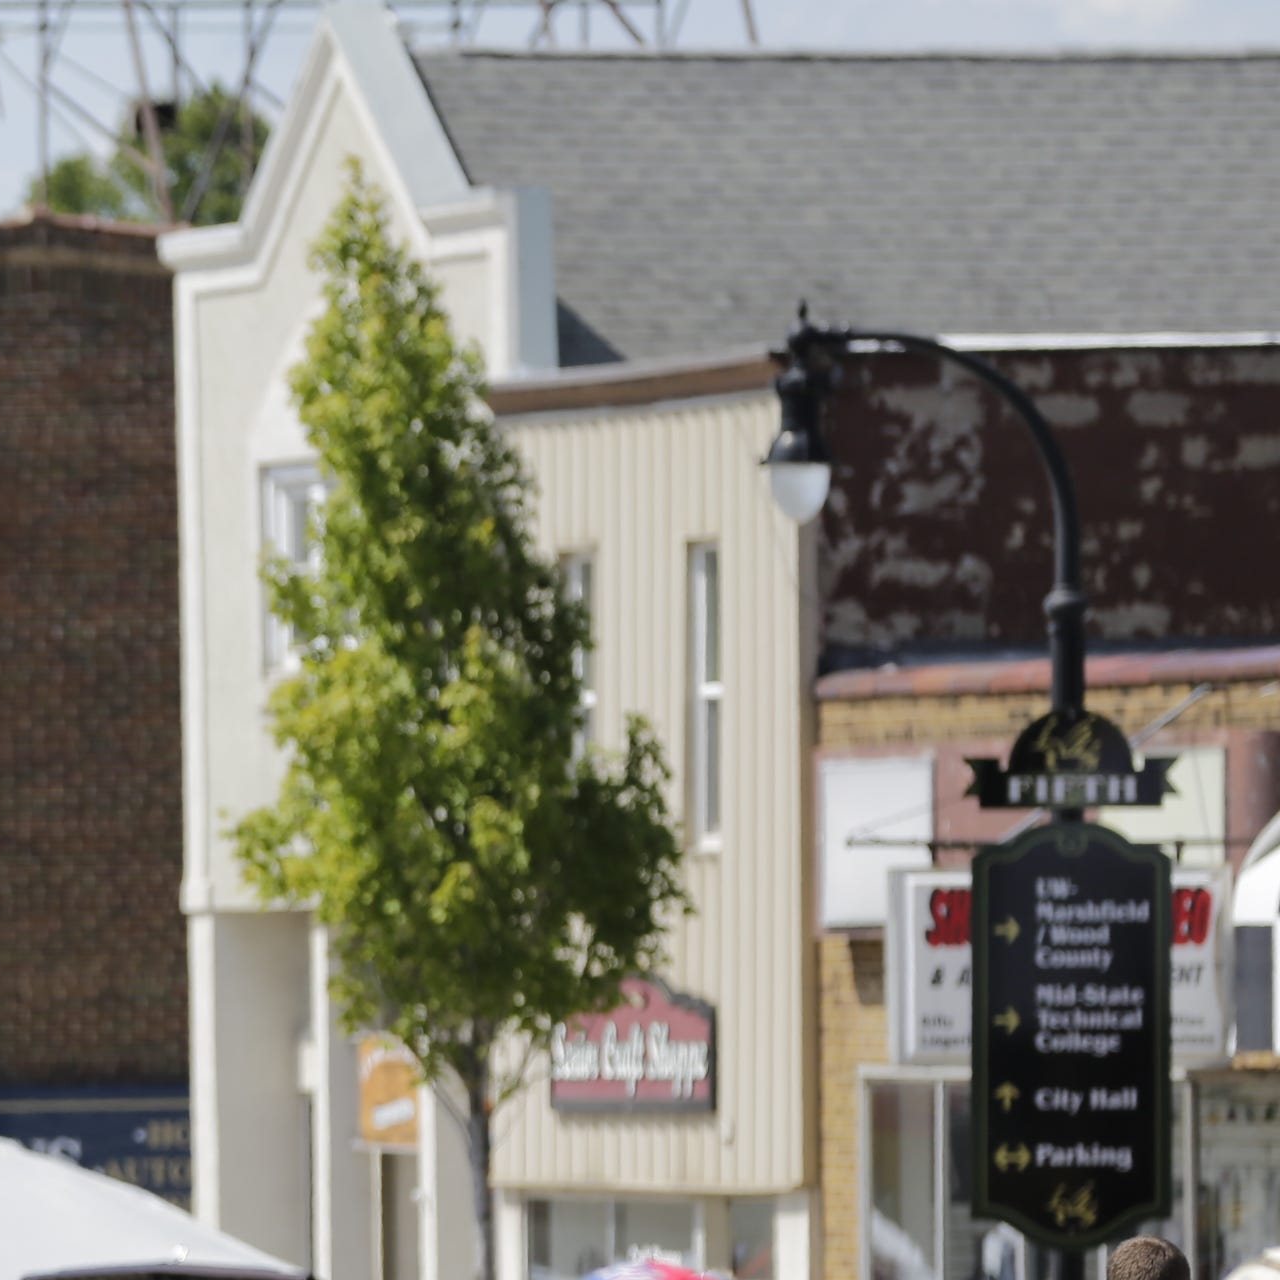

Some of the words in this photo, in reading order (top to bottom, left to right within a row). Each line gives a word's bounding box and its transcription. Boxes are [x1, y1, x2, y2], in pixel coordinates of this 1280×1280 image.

[1035, 900, 1151, 923] Marshfield
[1034, 945, 1114, 974] County
[1034, 983, 1145, 1007] Mid-State
[1036, 1006, 1145, 1031] Technical
[1034, 1030, 1123, 1058] College
[1034, 1086, 1083, 1117] City
[1089, 1086, 1139, 1111] Hall
[1035, 1142, 1135, 1174] Parking
